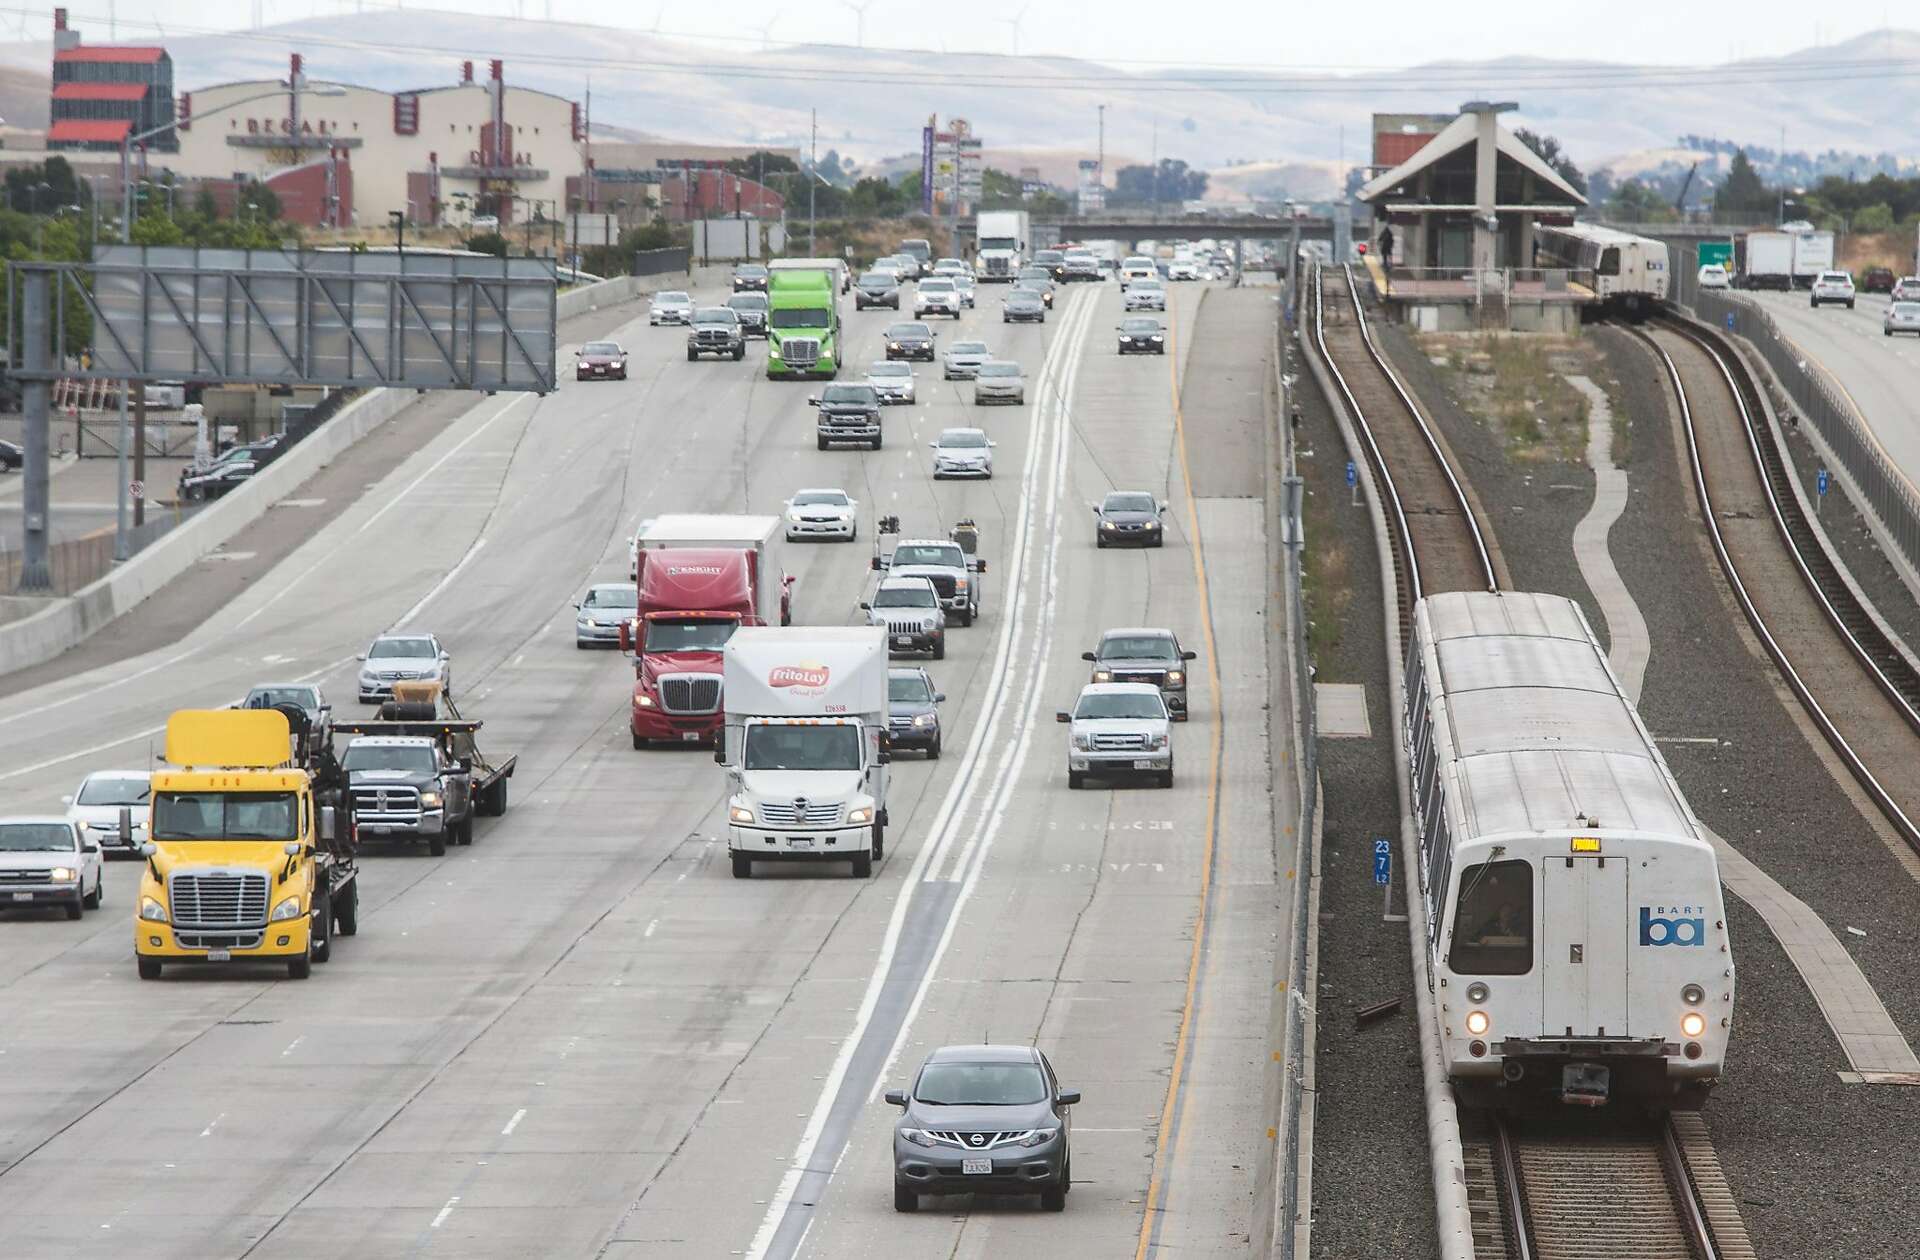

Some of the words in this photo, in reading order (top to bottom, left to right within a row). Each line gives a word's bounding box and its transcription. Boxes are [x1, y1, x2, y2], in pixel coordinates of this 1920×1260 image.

[1375, 840, 1390, 853] 23
[1378, 857, 1387, 870] 7
[1376, 874, 1388, 883] L2
[1657, 906, 1704, 914] BART
